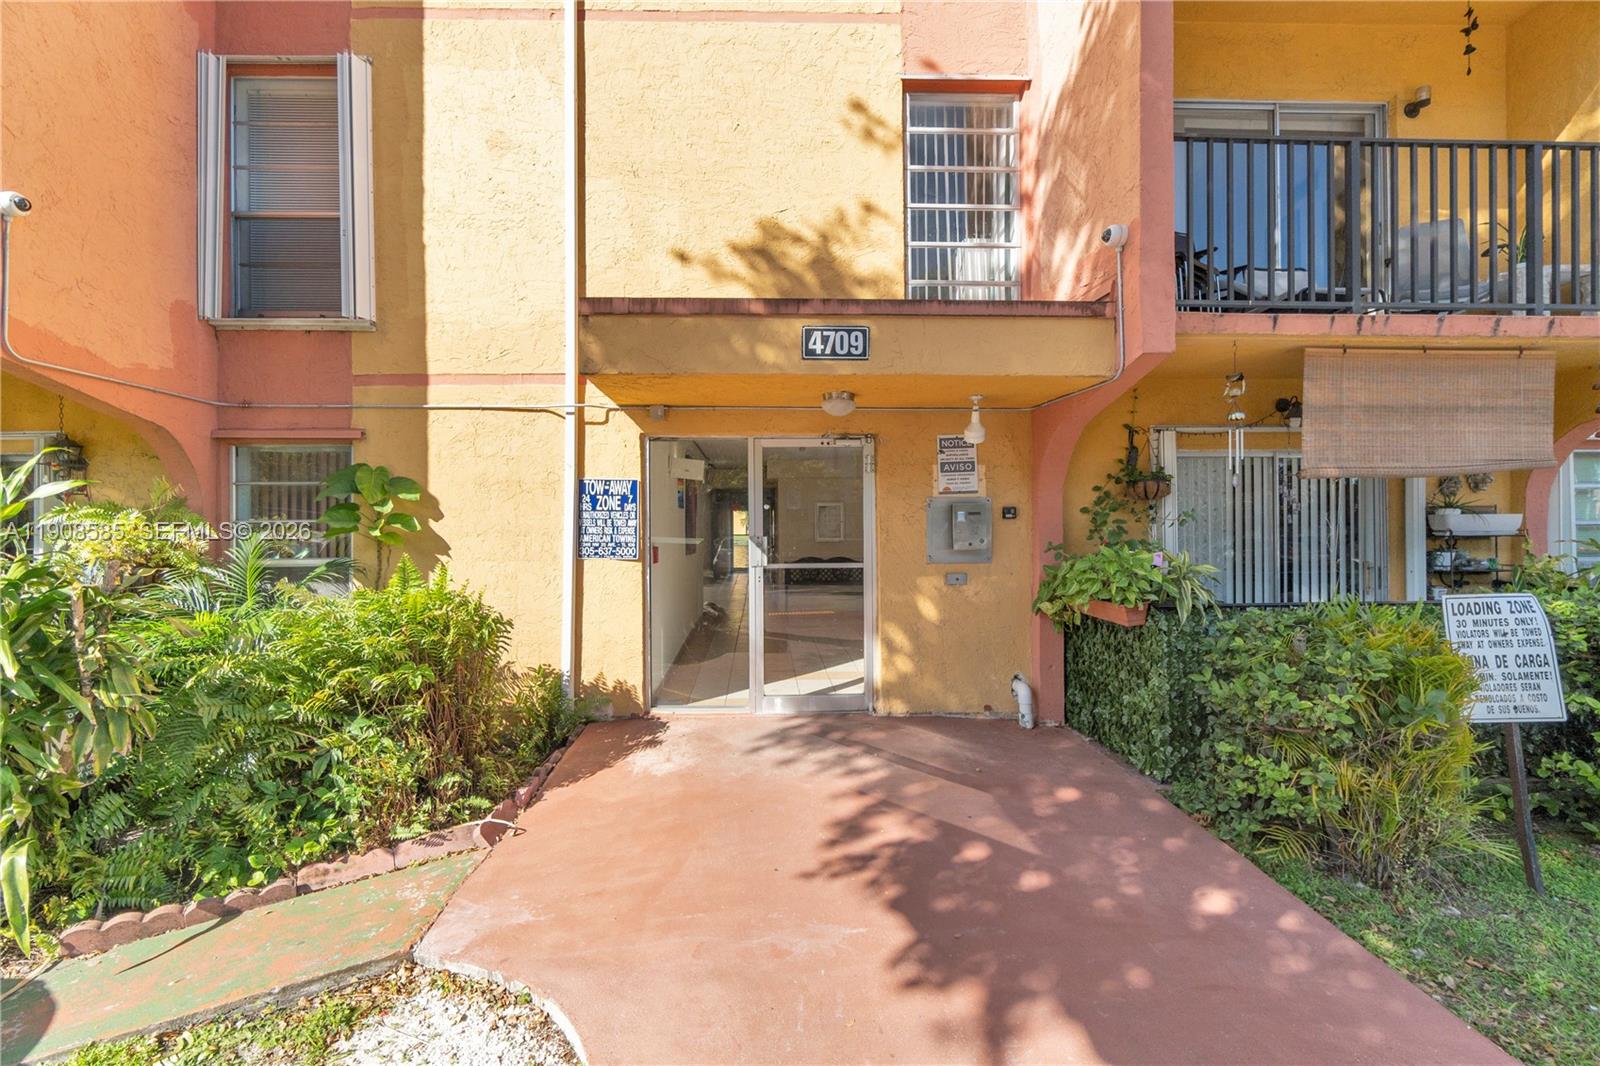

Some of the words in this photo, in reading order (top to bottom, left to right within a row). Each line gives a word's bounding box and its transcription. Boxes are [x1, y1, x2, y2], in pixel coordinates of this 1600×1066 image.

[808, 330, 864, 355] 4709
[943, 463, 973, 472] AVISO
[583, 480, 633, 496] TOW-AWAY
[582, 494, 591, 503] 24
[596, 495, 622, 511] ZONE
[628, 494, 634, 503] 7
[624, 503, 637, 511] DAYS
[580, 534, 611, 543] AMERICAN
[612, 534, 636, 543] TOWING
[580, 547, 636, 555] 305-637-5000
[1451, 601, 1502, 616] LOADING
[1507, 600, 1537, 615] ZONE
[1456, 620, 1467, 628] 30
[1472, 618, 1509, 628] MINUTES
[1514, 617, 1539, 626] ONLY!
[1455, 629, 1490, 639] VIOLATORS
[1510, 628, 1519, 637] BE
[1521, 627, 1542, 637] TOWED
[1477, 640, 1484, 649] AT
[1488, 639, 1514, 649] OWNERS
[1467, 655, 1489, 669] NA
[1495, 655, 1508, 669] DE
[1514, 654, 1551, 668] CARGA
[1501, 671, 1553, 681] SOLAMENTE!
[1520, 682, 1541, 691] SERAN
[1527, 693, 1548, 702] COSTO
[1486, 705, 1495, 714] DE
[1498, 705, 1511, 714] SUS
